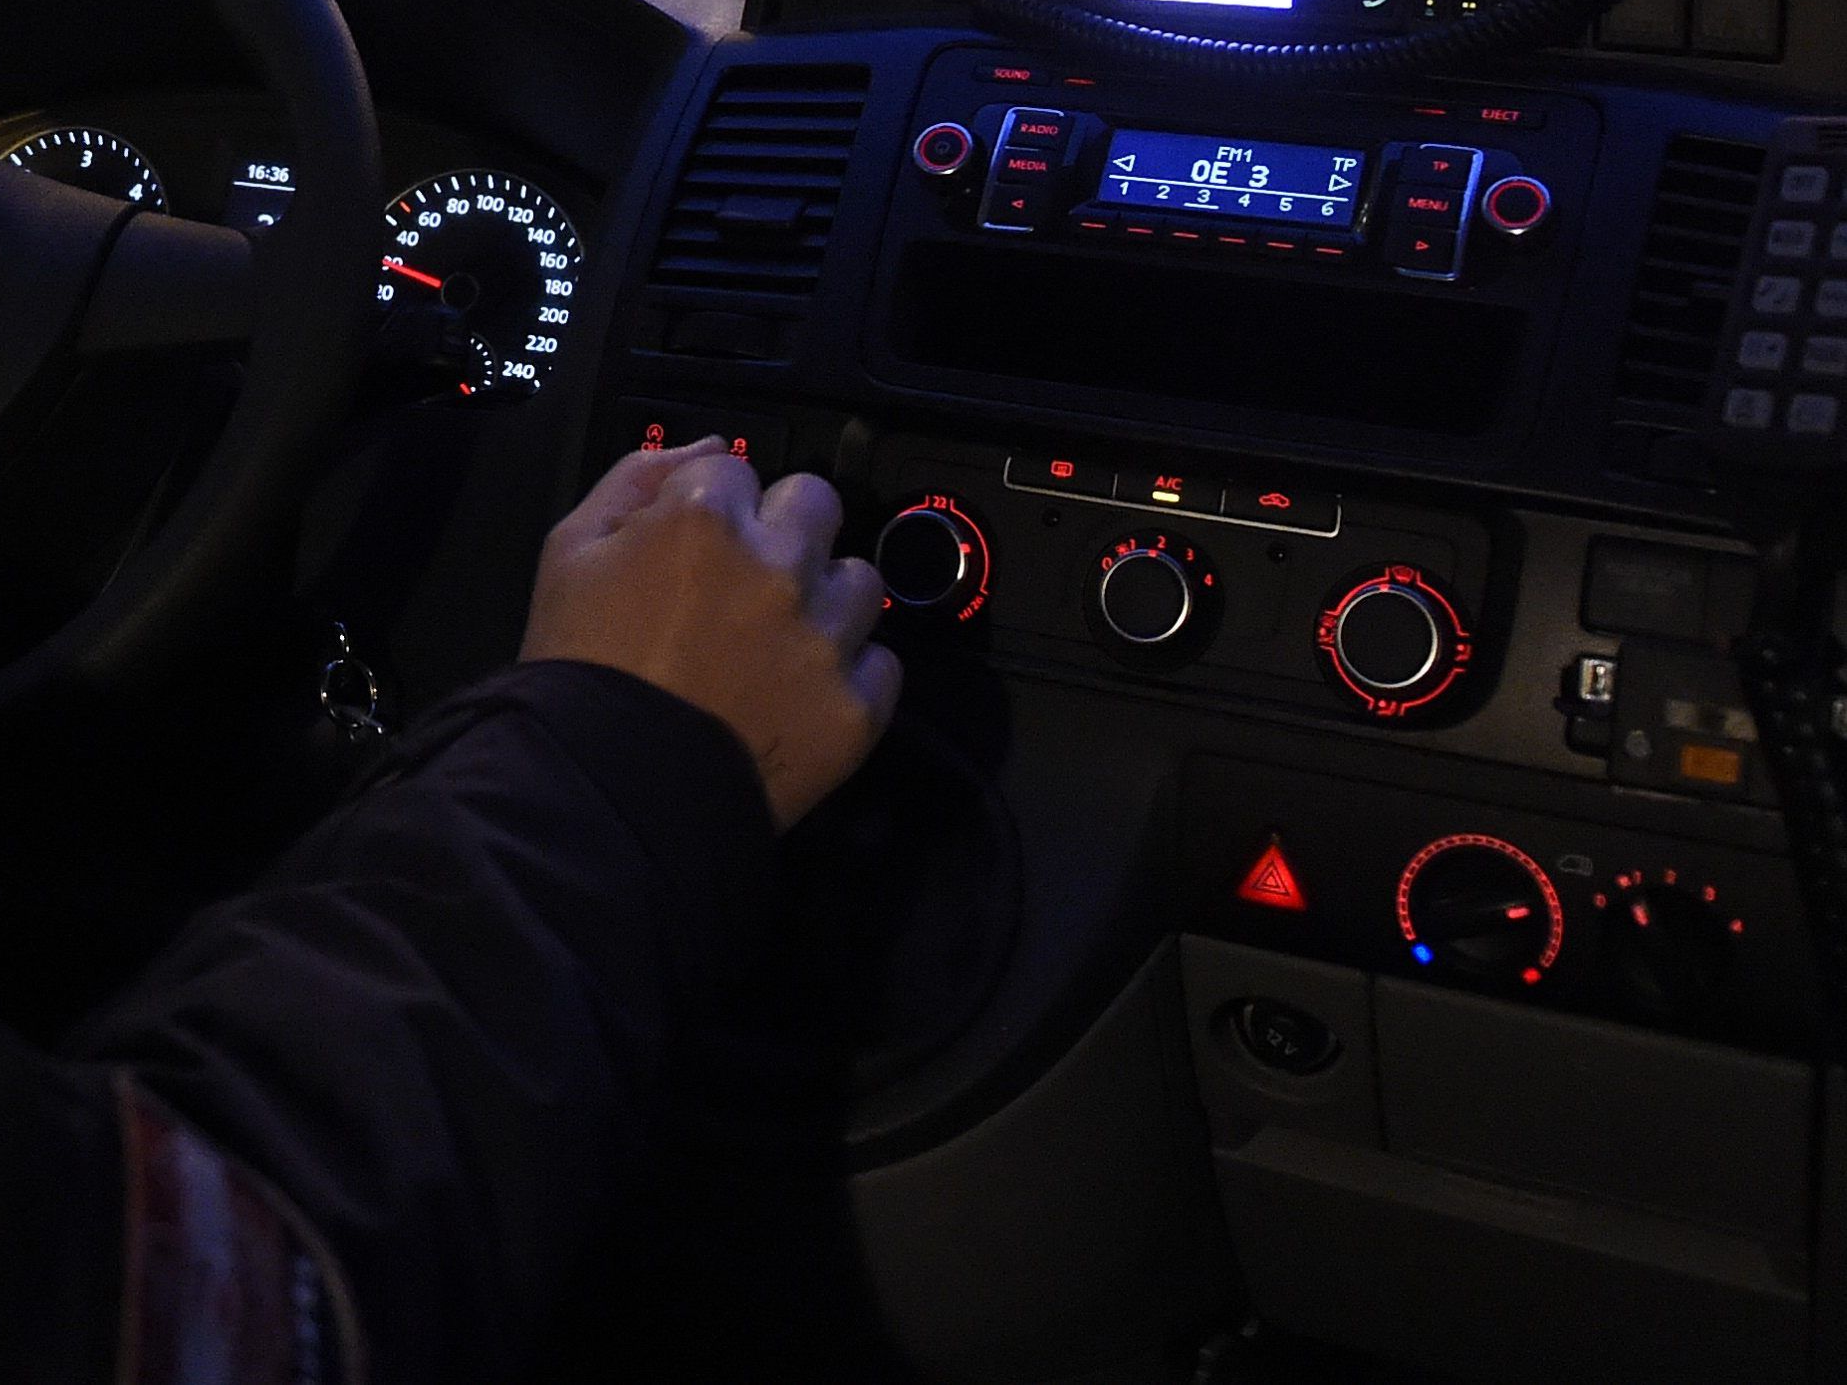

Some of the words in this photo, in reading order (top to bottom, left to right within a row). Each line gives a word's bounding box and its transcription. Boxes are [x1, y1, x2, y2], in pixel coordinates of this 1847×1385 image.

[994, 68, 1031, 81] SOUND
[1480, 107, 1521, 122] EJECT
[1020, 123, 1059, 135] RADIO
[80, 150, 93, 168] 3
[1217, 146, 1252, 163] FM1
[248, 164, 290, 183] 16:36
[1008, 159, 1047, 171] MEDIA
[1333, 157, 1358, 172] TP
[1432, 160, 1451, 172] TP
[1248, 165, 1270, 188] 3
[128, 183, 143, 201] 4
[1120, 181, 1129, 195] 1
[1156, 185, 1170, 200] 2
[1196, 189, 1211, 203] 3
[1238, 193, 1250, 207] 4
[1279, 197, 1294, 212] 5
[1321, 202, 1335, 216] 6
[446, 197, 470, 215] 80
[476, 194, 505, 212] 100
[1407, 197, 1450, 212] MENU
[418, 211, 442, 228] 60
[508, 206, 534, 224] 120
[396, 230, 420, 247] 40
[527, 227, 556, 245] 140
[539, 251, 568, 270] 160
[545, 279, 573, 296] 180
[538, 306, 569, 324] 200
[525, 334, 558, 353] 220
[502, 360, 535, 380] 240
[1155, 474, 1184, 491] A/C
[932, 495, 948, 509] 22
[1101, 556, 1113, 571] 0
[1128, 537, 1136, 551] 1
[1156, 534, 1167, 549] 2
[1185, 547, 1195, 563] 3
[1203, 573, 1215, 587] 4
[1265, 1027, 1284, 1047] 12
[1284, 1041, 1299, 1056] V
